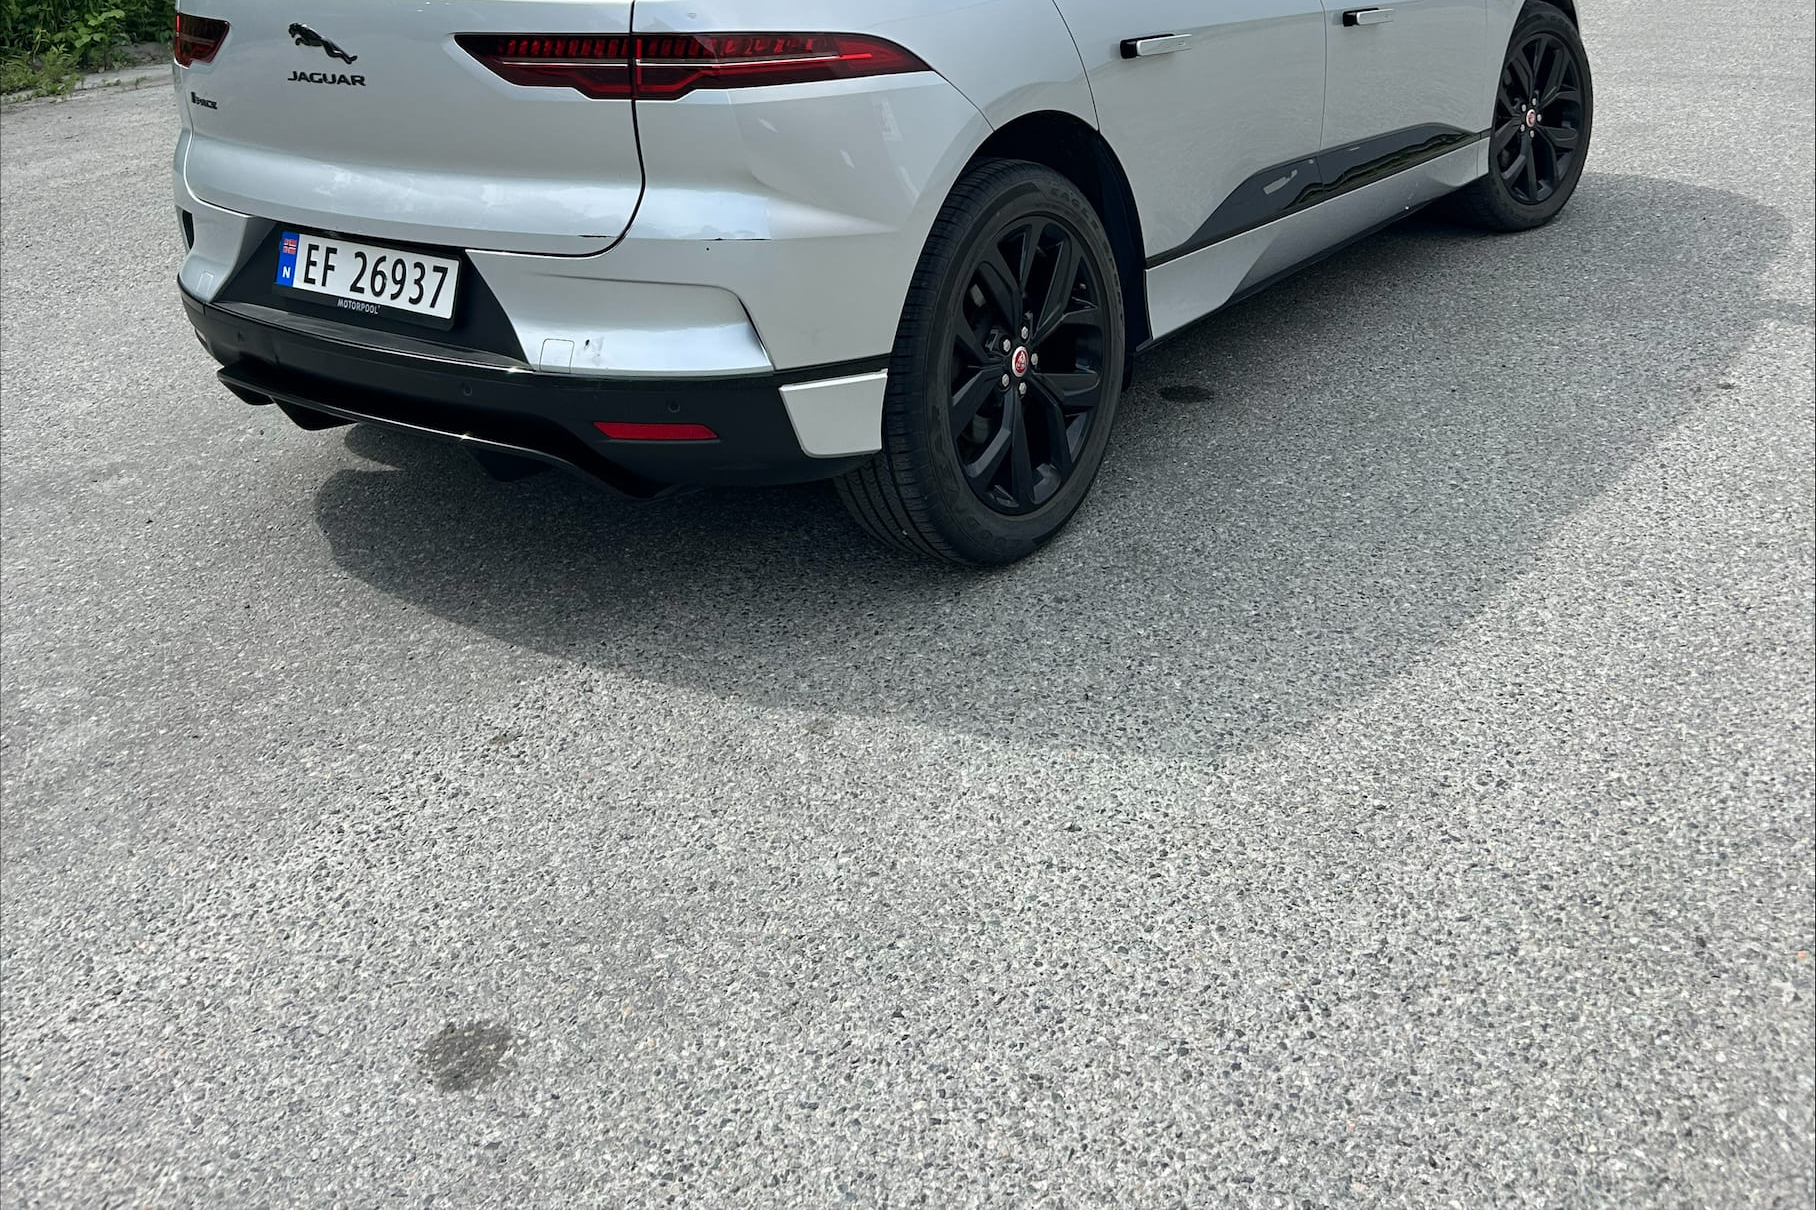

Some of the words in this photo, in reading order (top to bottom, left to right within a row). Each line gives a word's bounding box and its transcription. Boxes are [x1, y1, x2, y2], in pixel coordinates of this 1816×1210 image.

[287, 70, 366, 87] JAGUAR
[282, 266, 291, 279] N
[303, 243, 338, 288] EF
[350, 250, 449, 309] 26937
[336, 298, 379, 315] MOTORPOOL
